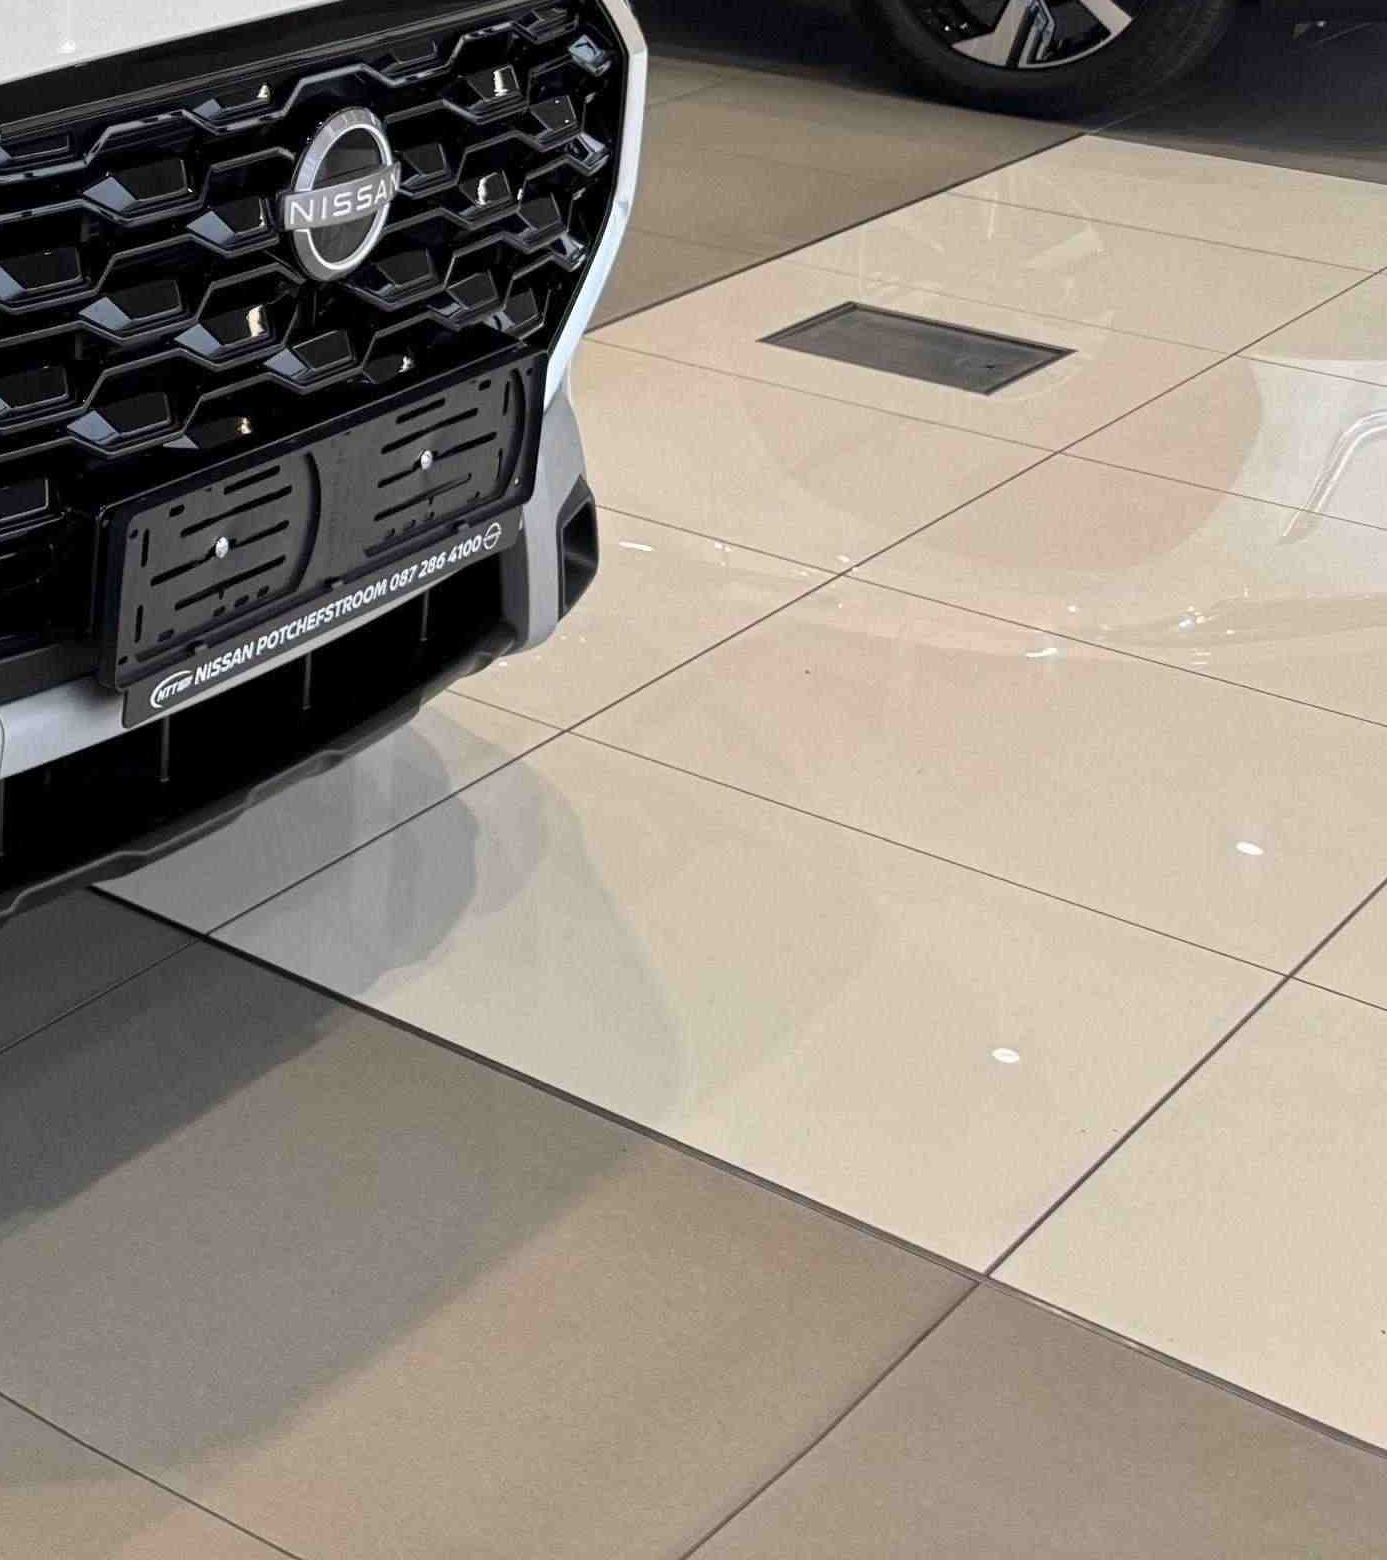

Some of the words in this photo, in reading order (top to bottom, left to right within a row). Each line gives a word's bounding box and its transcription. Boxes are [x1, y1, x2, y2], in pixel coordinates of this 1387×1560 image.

[289, 168, 400, 227] NISSAN
[194, 640, 255, 686] NISSAN
[255, 577, 388, 656] POTCHEFSTROOM
[389, 566, 421, 592] 087
[418, 551, 447, 578] 286
[447, 534, 482, 564] 4100
